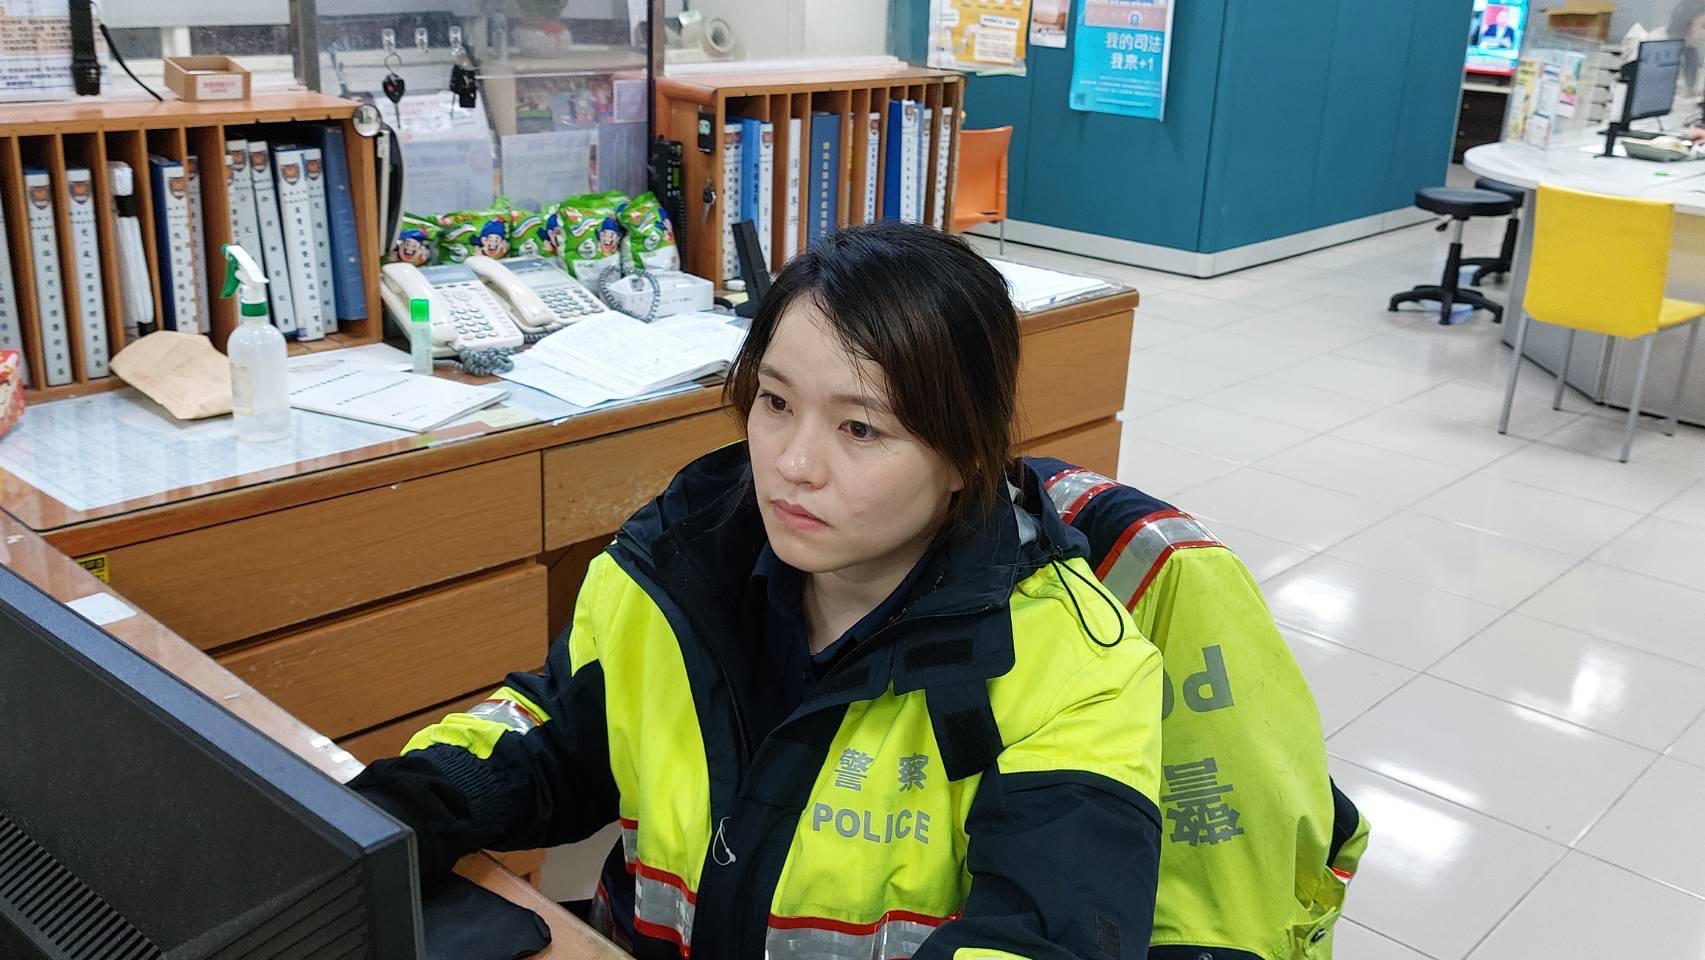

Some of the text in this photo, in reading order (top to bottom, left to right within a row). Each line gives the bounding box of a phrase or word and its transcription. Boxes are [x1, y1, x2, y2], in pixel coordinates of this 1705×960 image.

[1106, 32, 1161, 52] 我的司法
[1161, 757, 1244, 847] 警
[812, 803, 931, 845] POLICE
